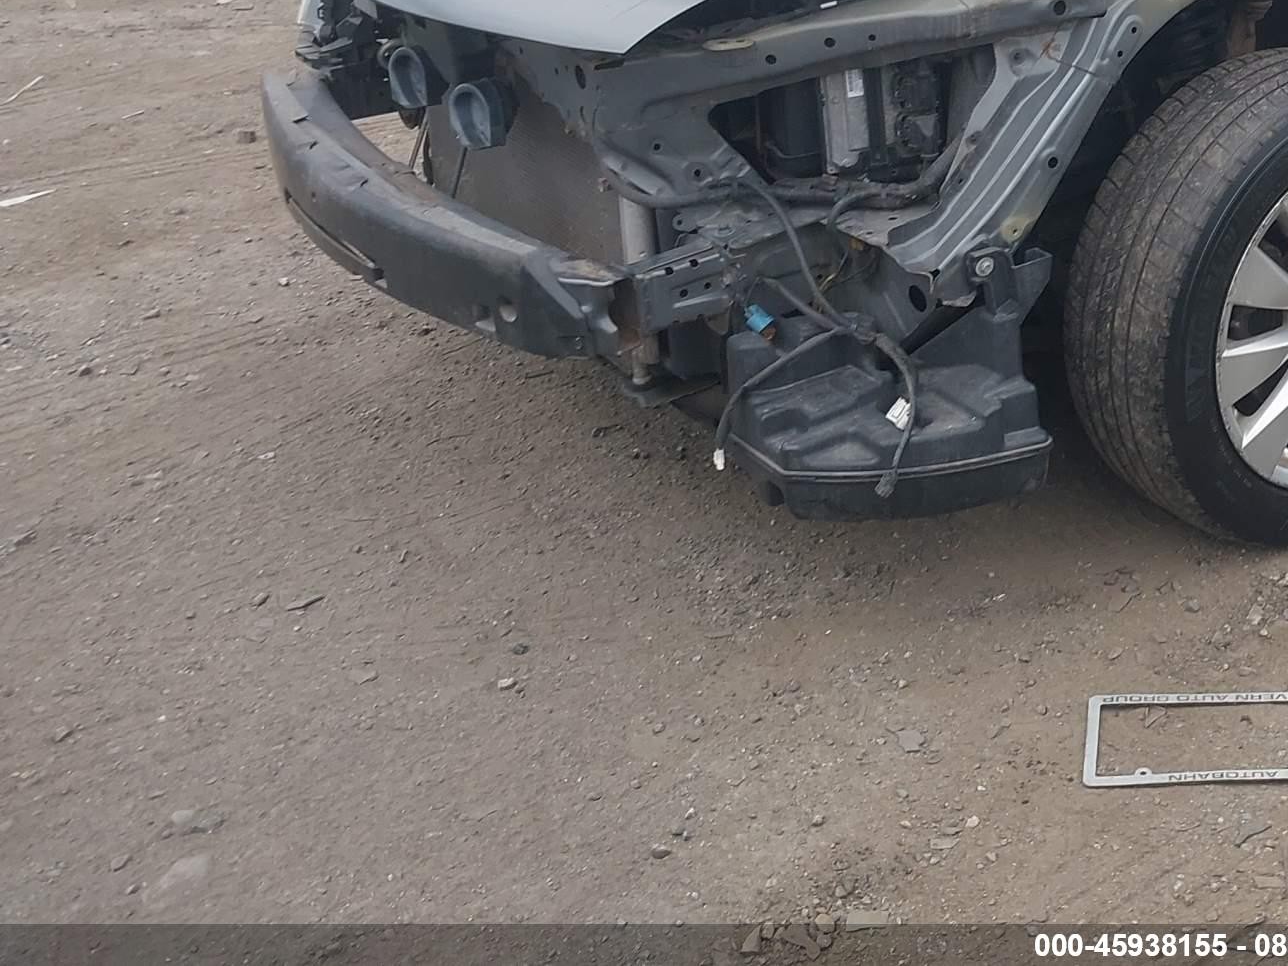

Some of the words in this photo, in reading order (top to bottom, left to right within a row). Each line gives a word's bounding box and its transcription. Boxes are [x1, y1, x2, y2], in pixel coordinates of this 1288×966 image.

[1102, 694, 1168, 703] GROUP
[1177, 693, 1226, 703] AUTO
[1168, 770, 1279, 782] AUTOBAHN
